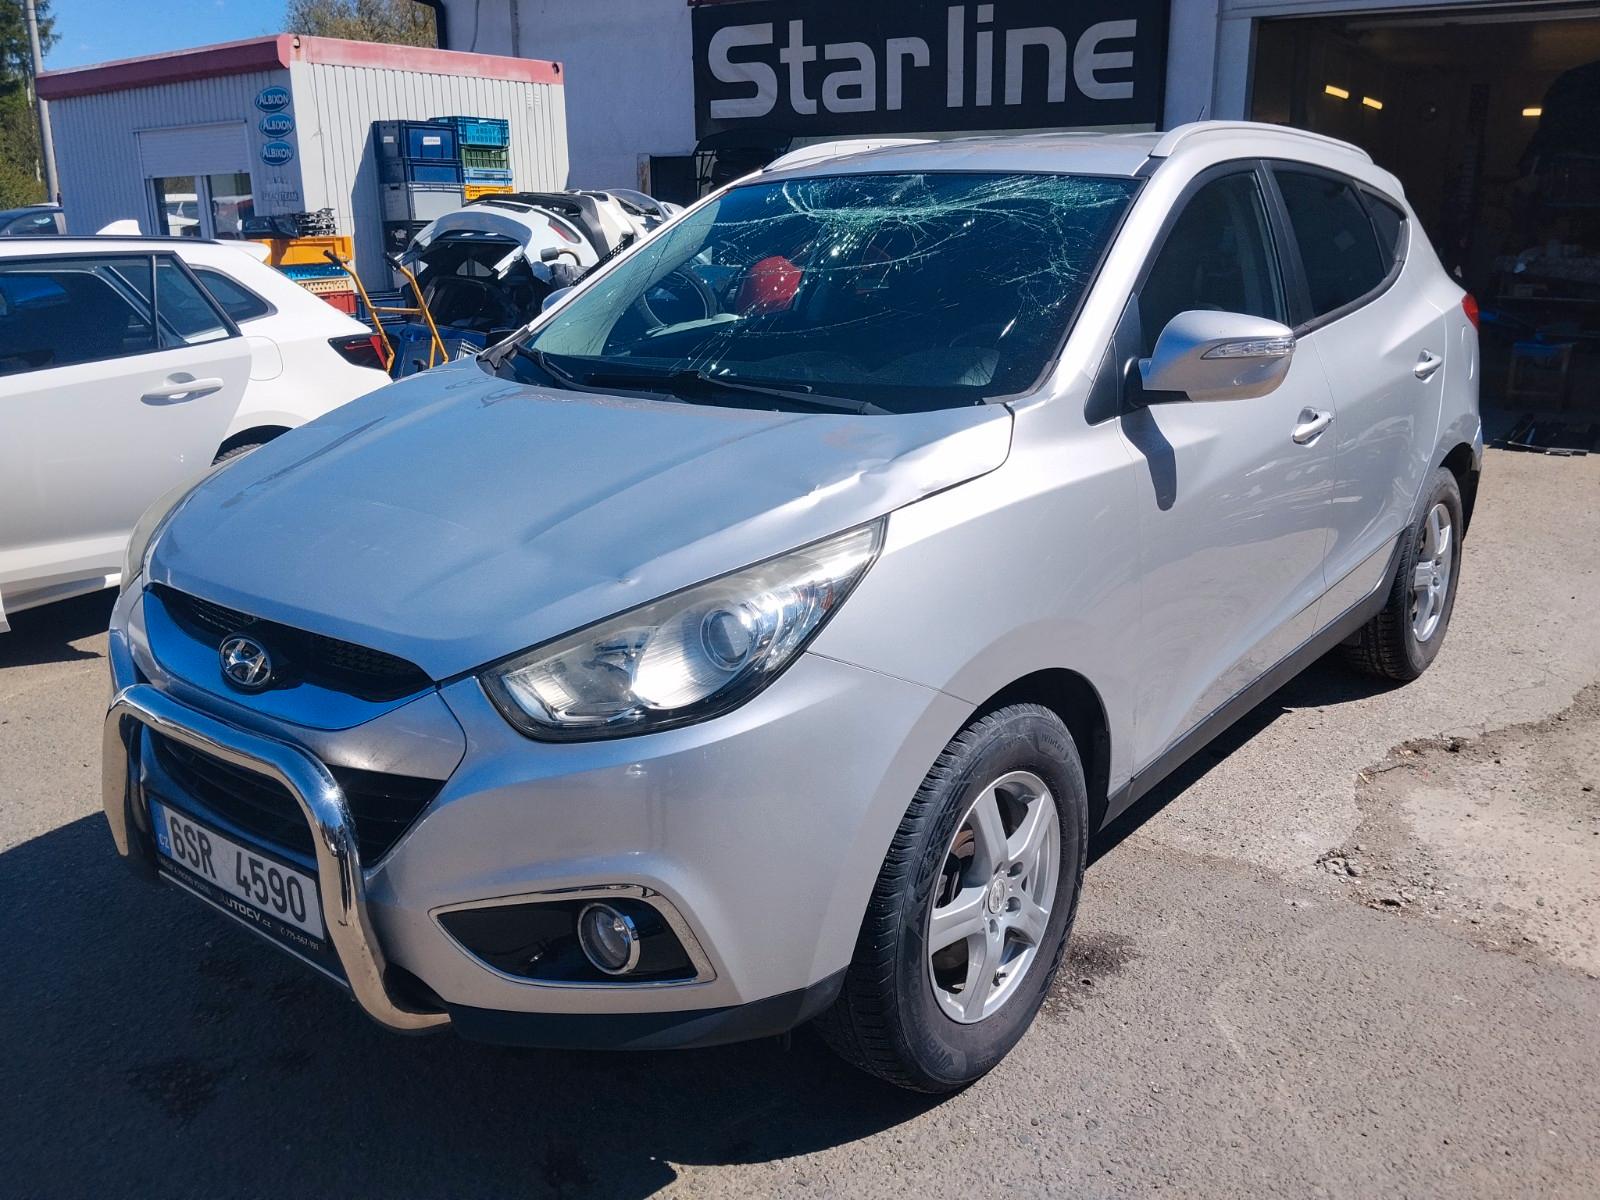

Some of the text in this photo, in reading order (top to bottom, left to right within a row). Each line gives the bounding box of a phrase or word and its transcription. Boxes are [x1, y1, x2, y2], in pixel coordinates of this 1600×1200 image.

[708, 4, 1137, 119] Starline
[260, 94, 289, 105] ALBIXON
[263, 118, 293, 131] ALBIXON
[262, 145, 292, 158] ALBIXON
[158, 833, 169, 849] CZ
[170, 816, 217, 879] 6SR
[236, 851, 307, 923] 4590
